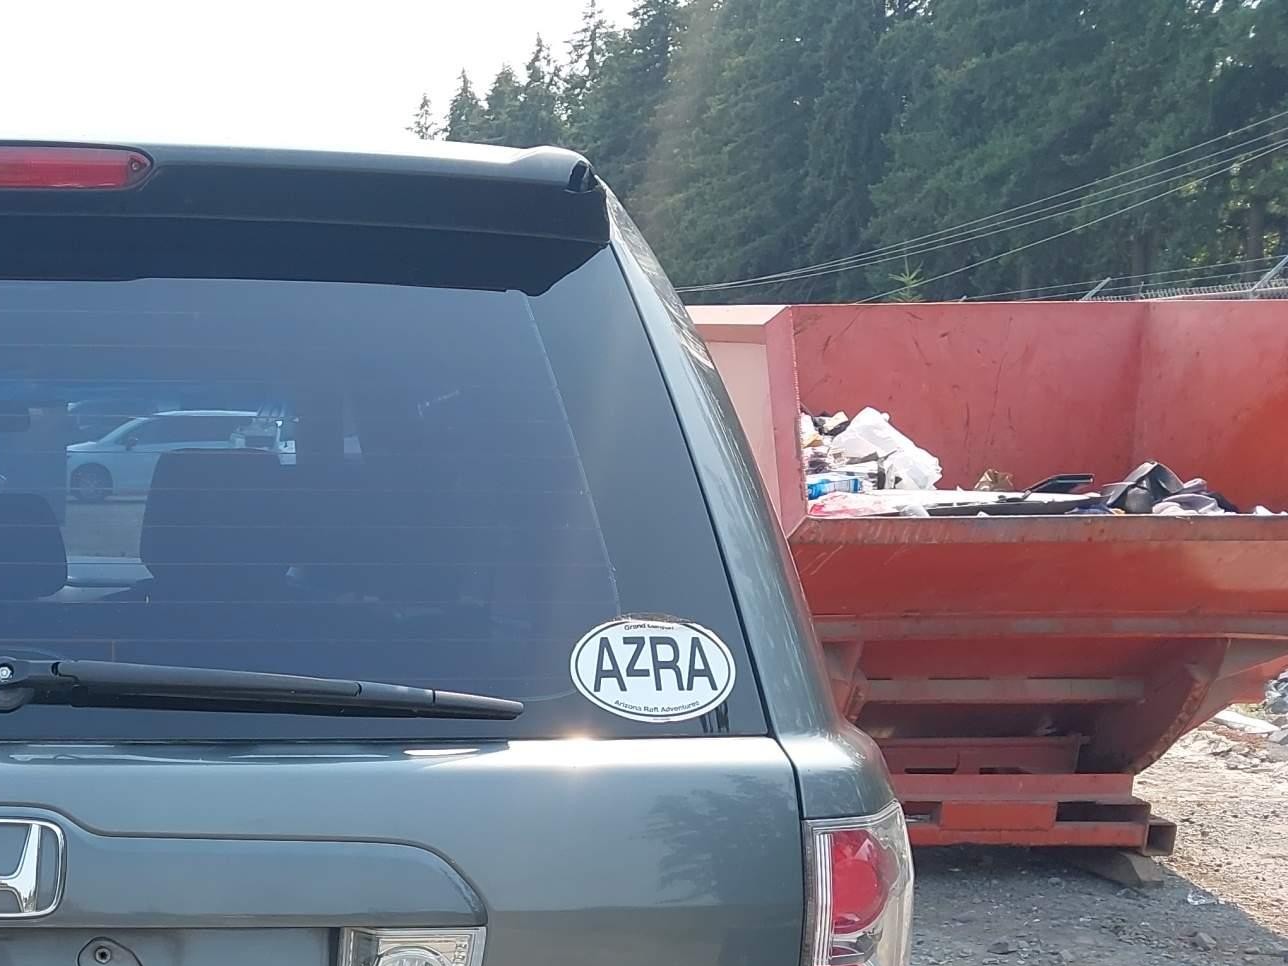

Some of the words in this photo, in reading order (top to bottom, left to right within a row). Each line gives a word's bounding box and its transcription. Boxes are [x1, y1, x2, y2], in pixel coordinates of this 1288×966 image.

[623, 622, 646, 631] Grand
[594, 636, 718, 692] AZRA
[614, 700, 642, 712] Arizona
[661, 700, 700, 713] Adventures
